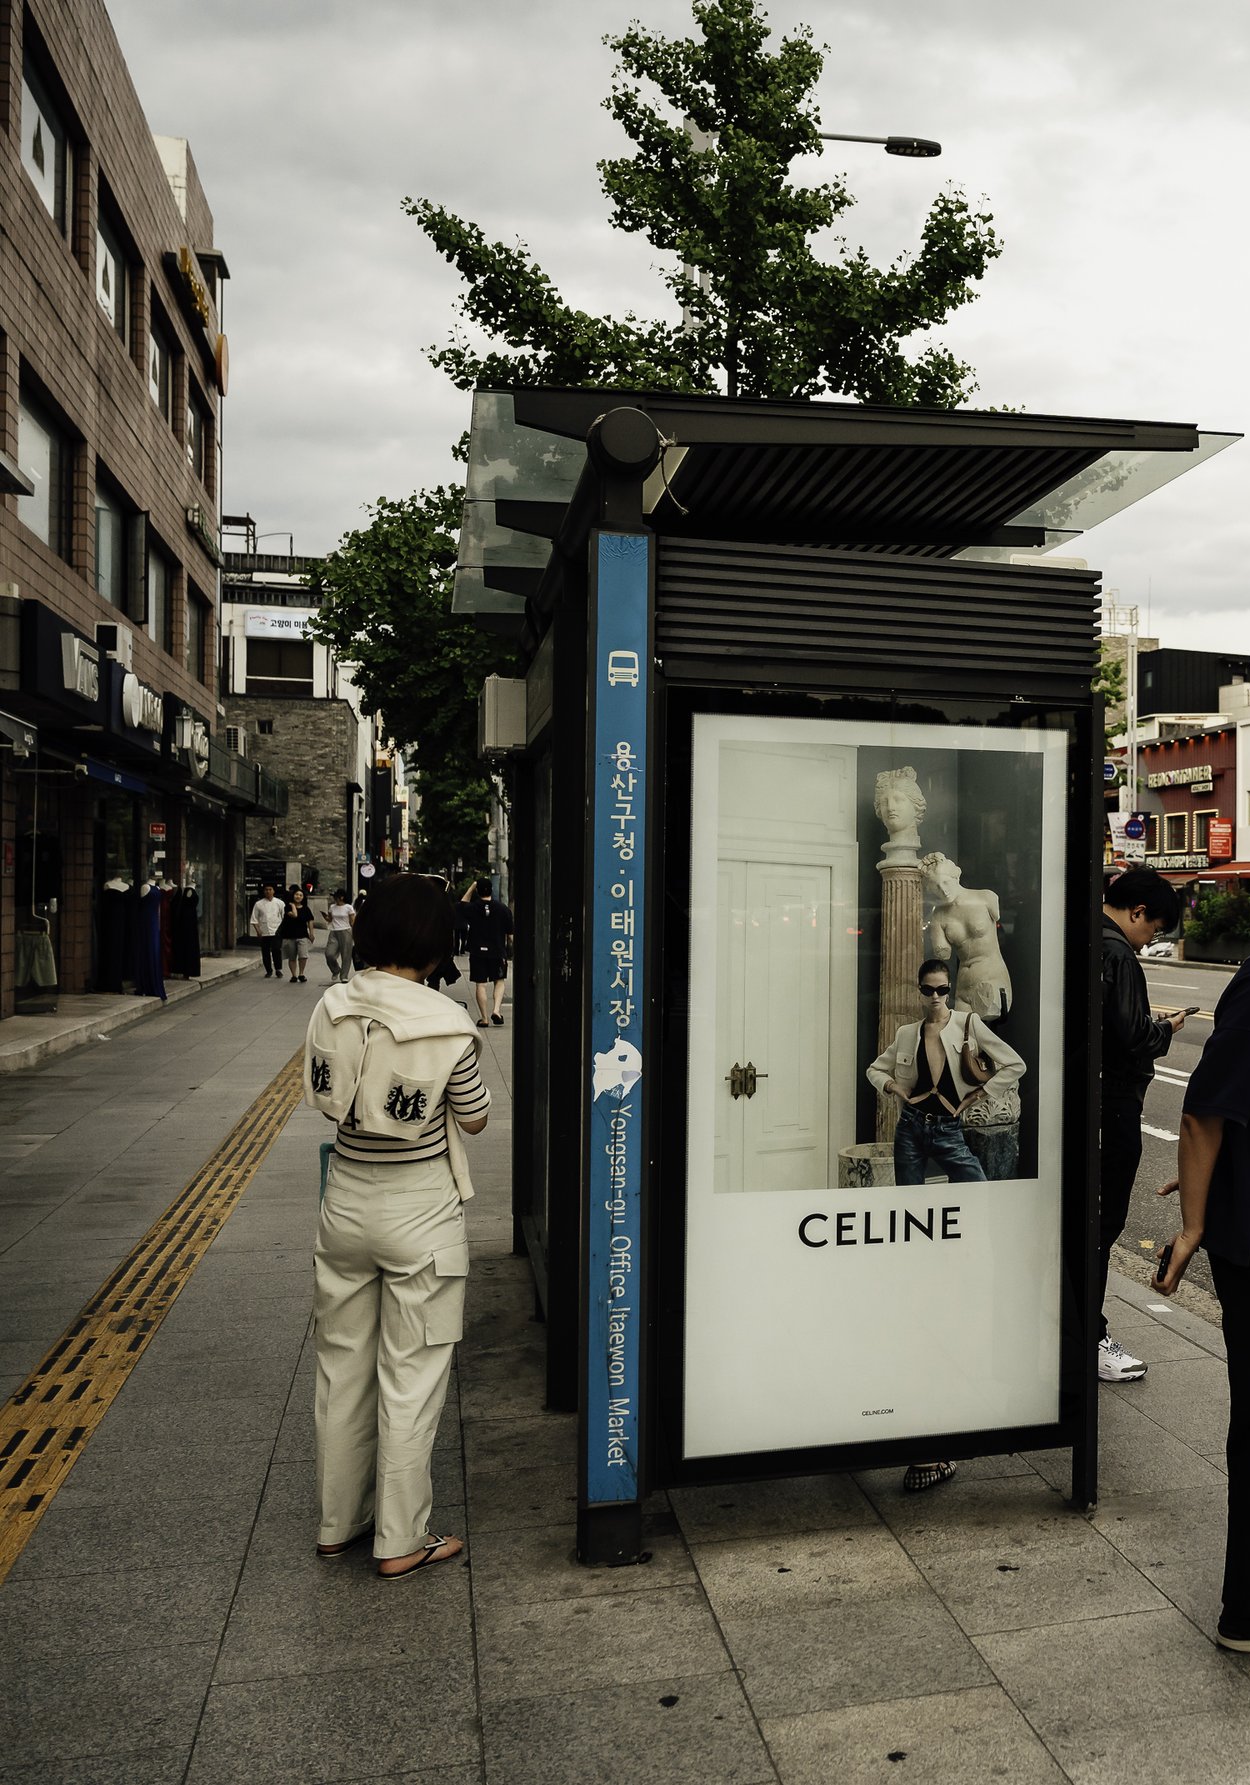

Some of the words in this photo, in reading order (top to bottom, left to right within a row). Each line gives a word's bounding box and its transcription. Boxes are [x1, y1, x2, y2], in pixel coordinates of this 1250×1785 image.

[270, 619, 292, 629] 고양이
[605, 1103, 632, 1226] Yongsan-gu
[798, 1206, 962, 1248] CELINE
[607, 1397, 630, 1467] Market
[861, 1407, 895, 1417] CELINE.COM
